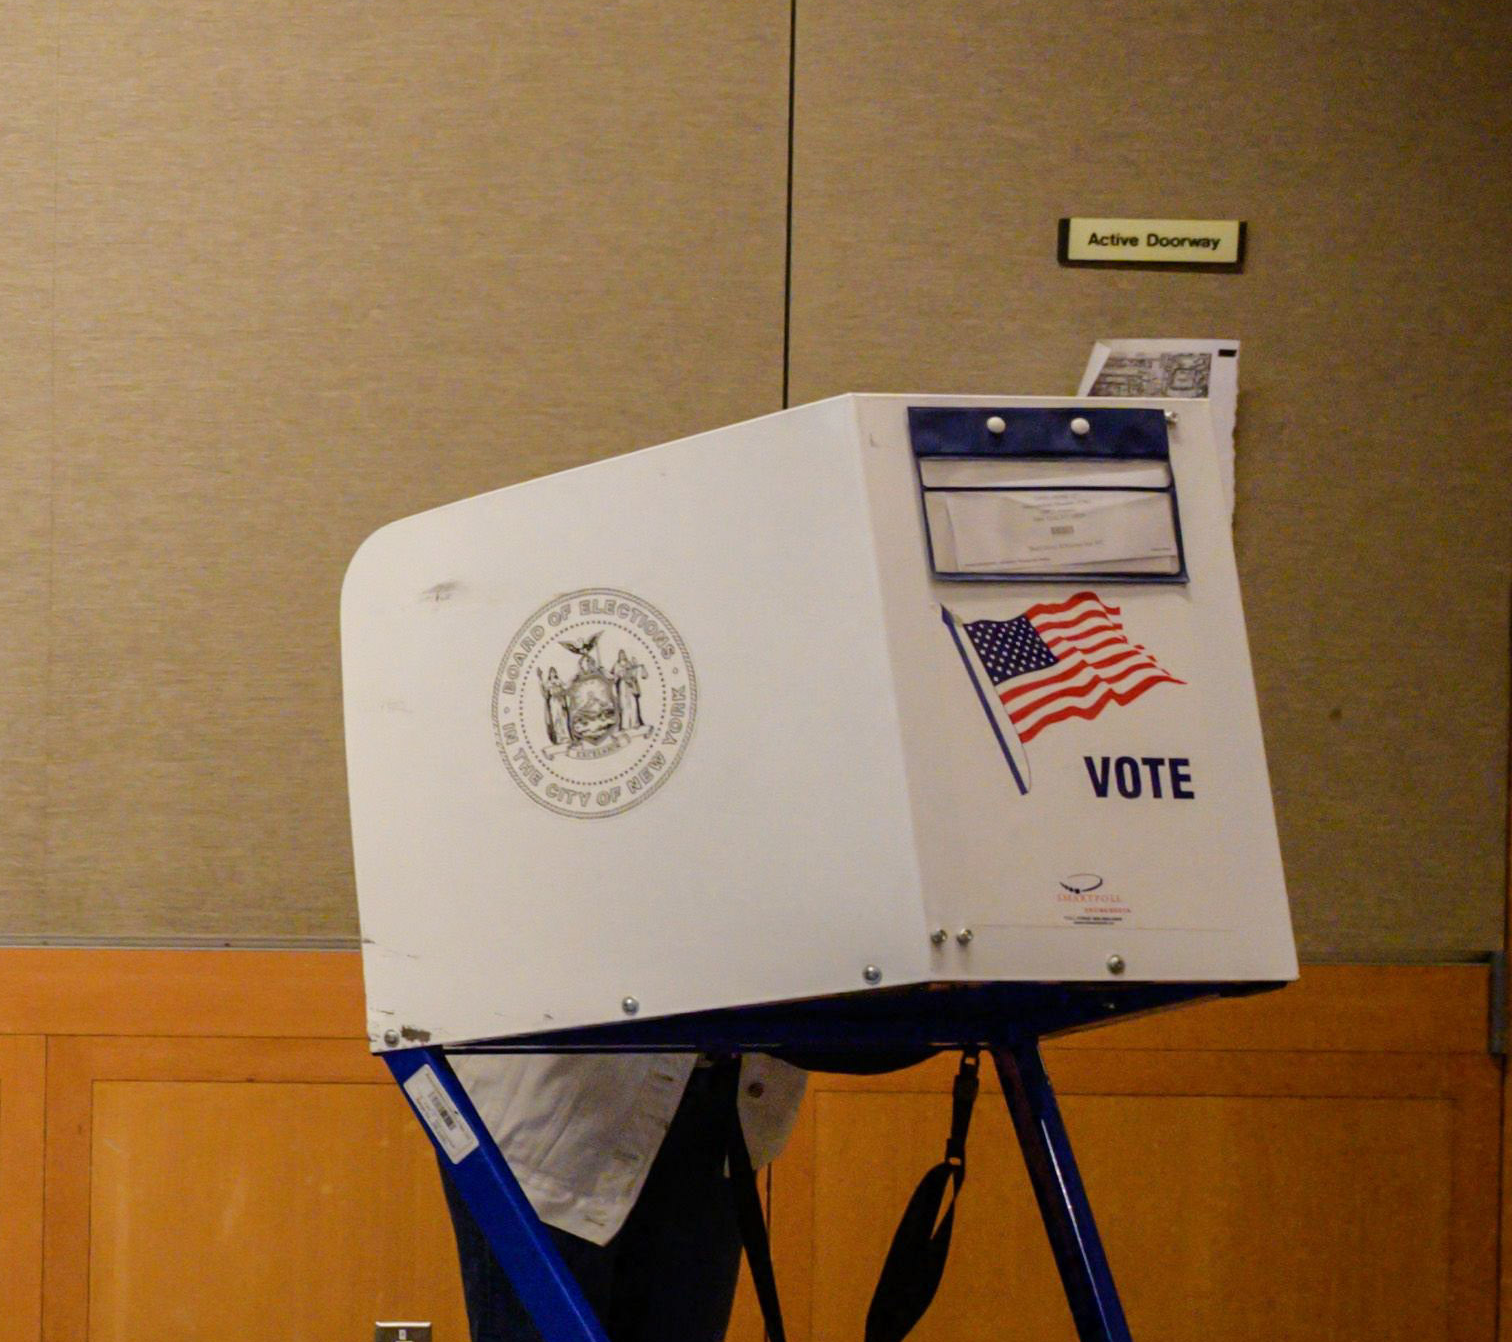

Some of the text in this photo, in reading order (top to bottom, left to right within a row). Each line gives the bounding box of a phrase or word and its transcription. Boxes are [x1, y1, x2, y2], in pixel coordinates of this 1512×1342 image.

[1088, 232, 1221, 250] Active Doorway
[502, 599, 676, 695] BOARD OF ELECTIONS
[502, 722, 519, 746] IN
[513, 747, 544, 786] THE
[545, 783, 592, 807] CITY
[596, 786, 621, 806] OF
[626, 750, 666, 794] NEW
[662, 685, 686, 746] YORK
[1084, 756, 1195, 800] VOTE
